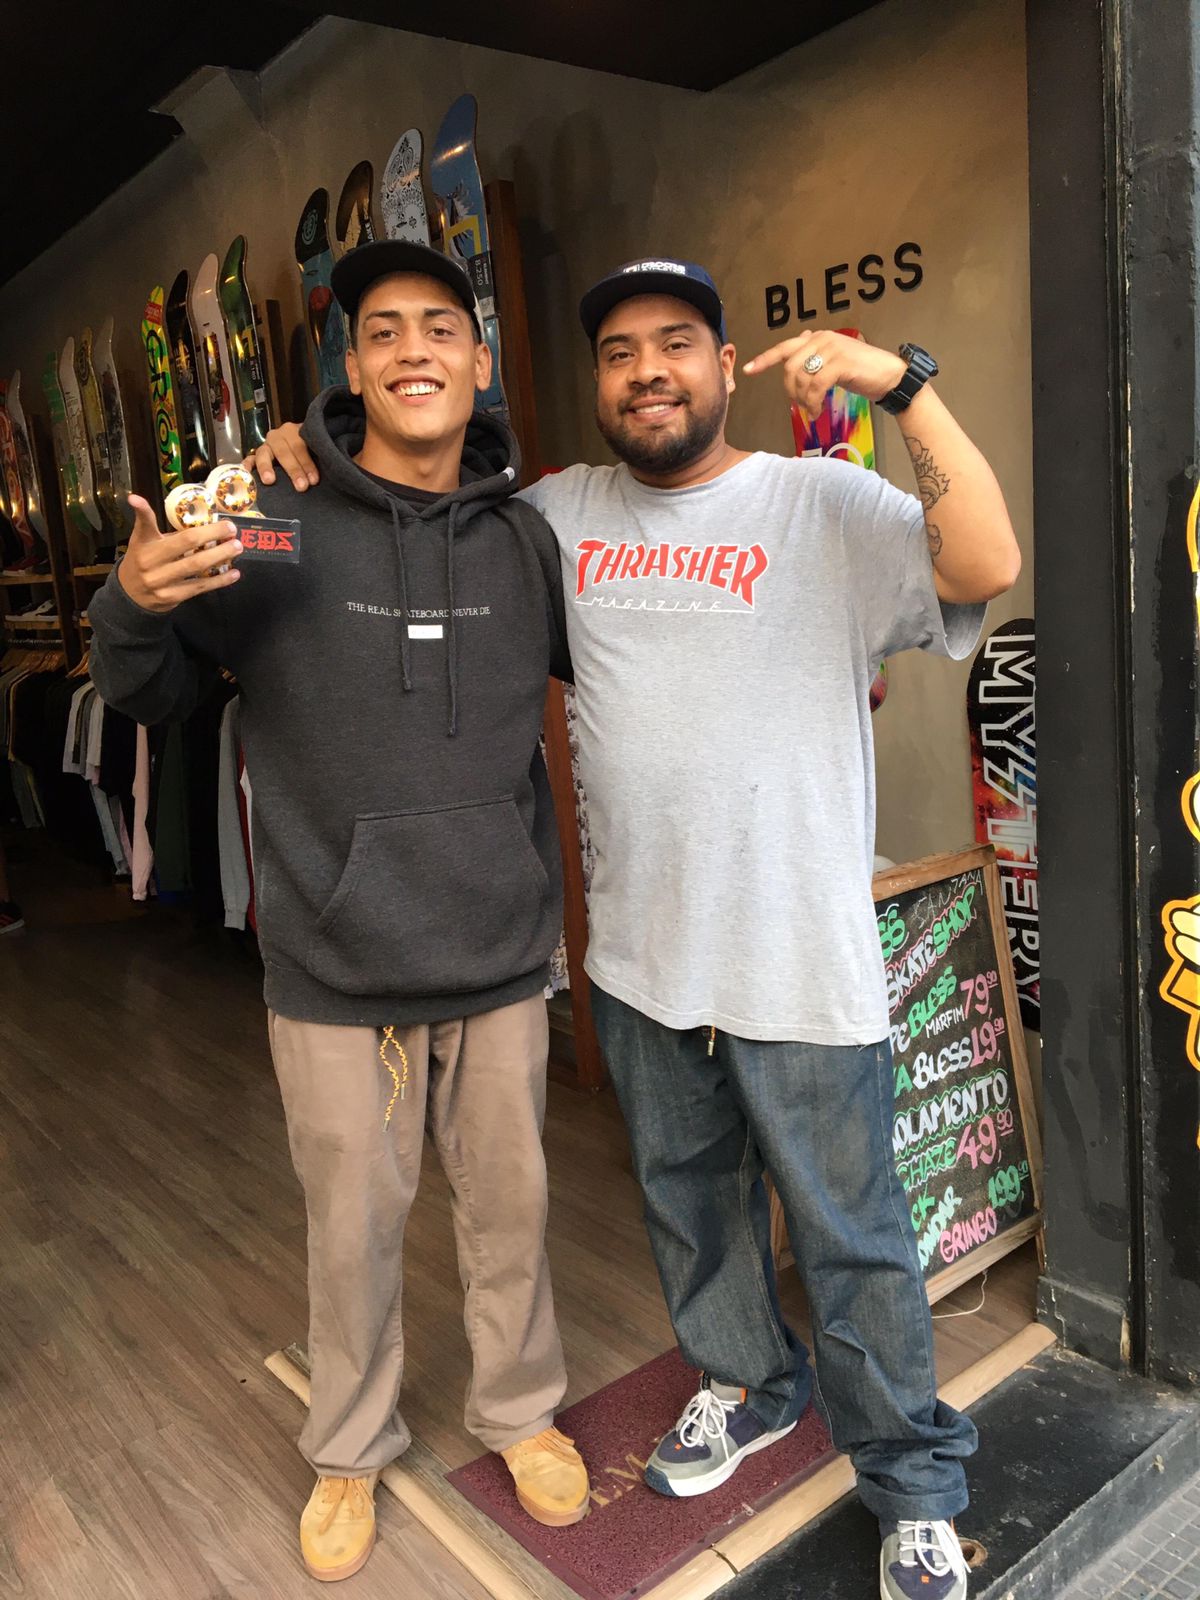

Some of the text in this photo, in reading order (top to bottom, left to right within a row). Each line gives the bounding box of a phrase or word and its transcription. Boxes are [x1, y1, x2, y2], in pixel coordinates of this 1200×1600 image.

[765, 242, 923, 329] BLESS
[575, 538, 769, 609] THRASHER
[346, 601, 367, 613] THE
[367, 604, 392, 617] REAL
[452, 607, 478, 617] NEVER
[479, 606, 491, 615] DIE
[590, 596, 723, 613] MAGAZINE
[907, 966, 957, 1039] BLESS
[925, 1005, 965, 1038] MARFIM
[912, 1037, 973, 1090] BLESS
[892, 1072, 1008, 1155] OLAMENTO
[939, 1206, 998, 1263] GRINGO
